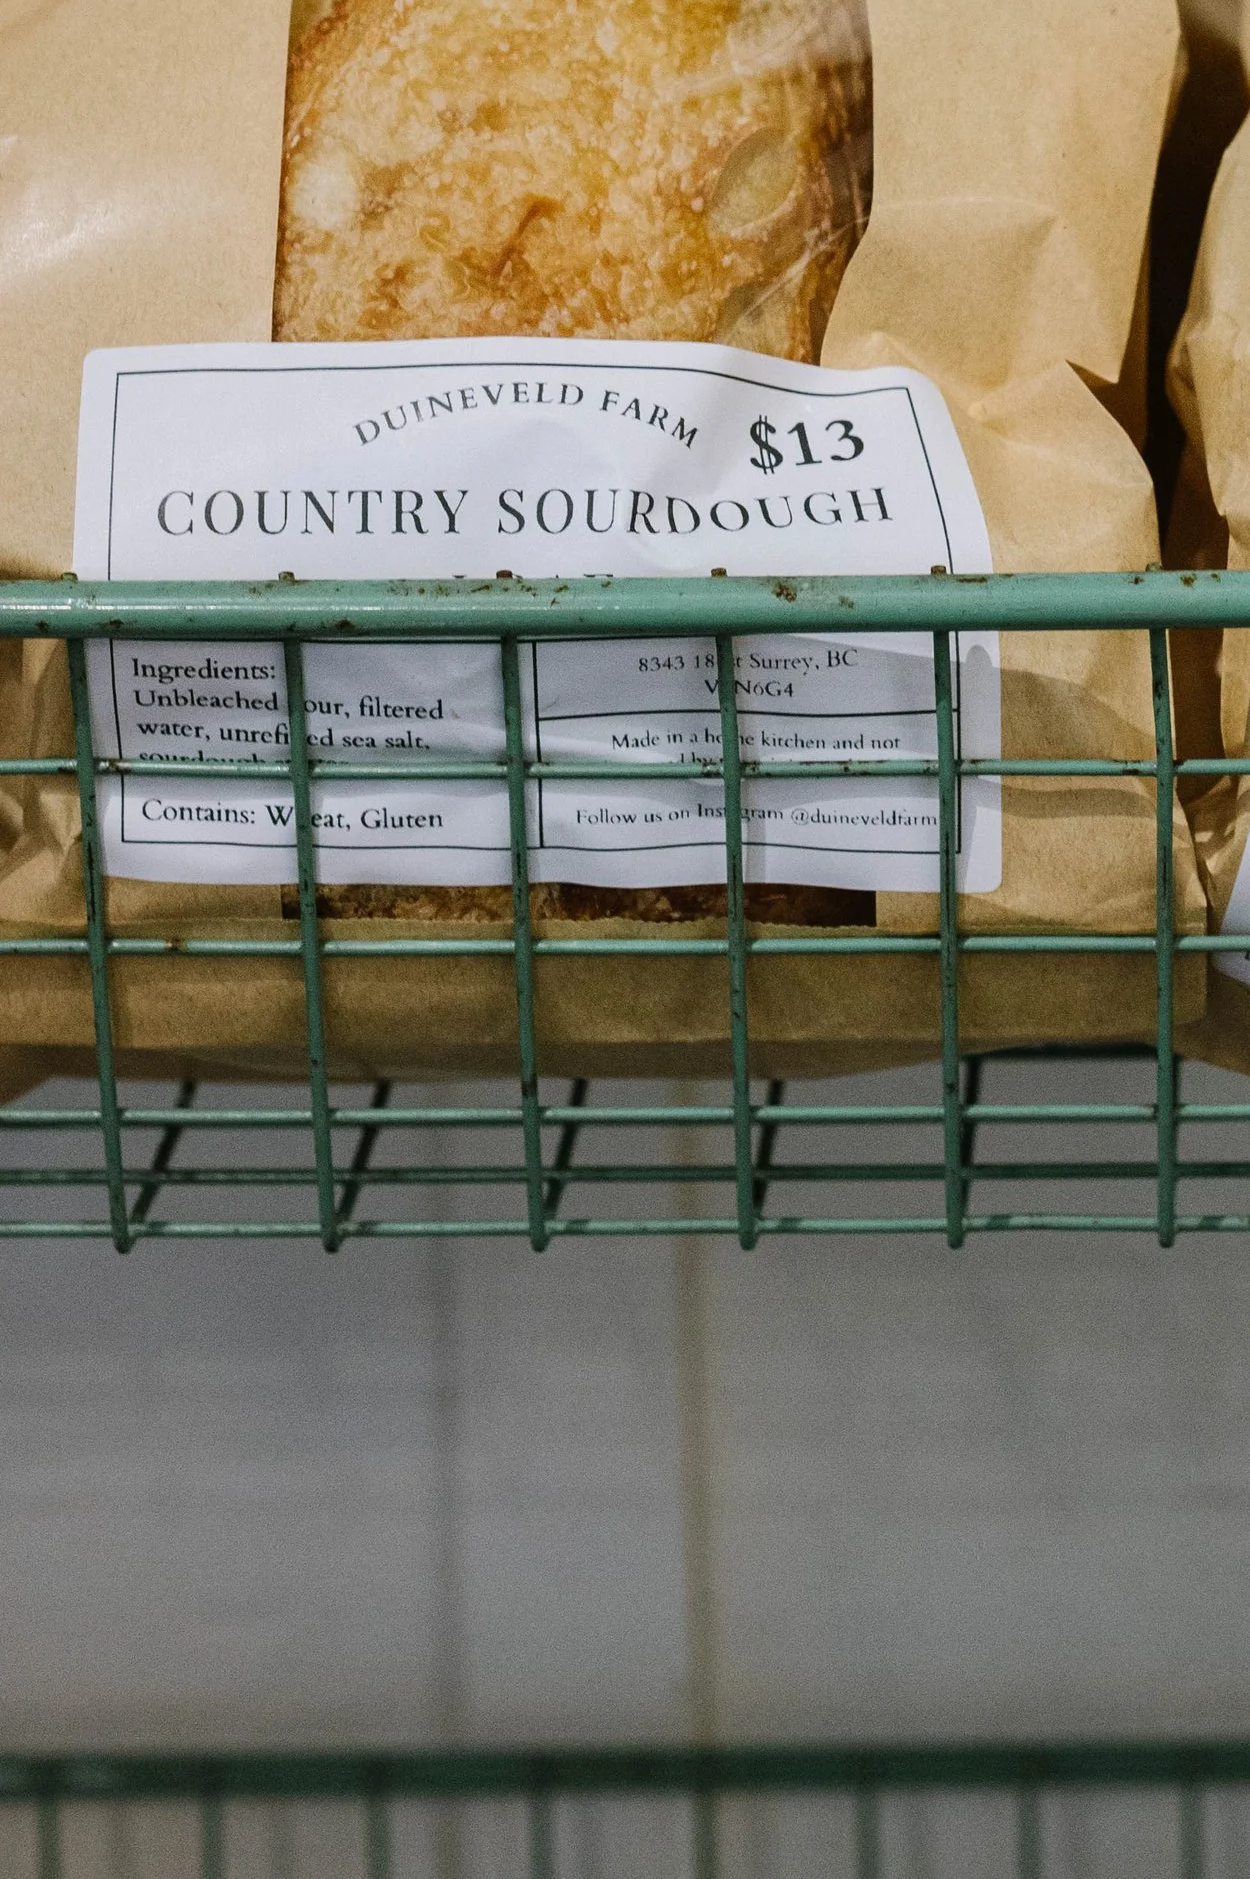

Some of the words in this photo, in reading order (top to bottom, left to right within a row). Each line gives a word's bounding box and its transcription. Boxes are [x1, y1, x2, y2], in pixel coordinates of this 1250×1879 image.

[352, 381, 586, 447] DUINEVELD
[600, 389, 698, 450] FARM
[748, 414, 866, 476] $13
[156, 487, 468, 536] COUNTRY
[496, 485, 895, 535] SOURDOUGH
[131, 657, 276, 685] Ingredients:
[638, 654, 686, 672] 8343
[749, 651, 820, 676] Surrey,
[826, 648, 859, 669] BC
[704, 679, 794, 698] VN6G4
[132, 688, 280, 712] Unbleached
[302, 697, 350, 719] our,
[359, 694, 444, 720] filtered
[136, 722, 211, 742] water,
[219, 721, 334, 748] unrefied
[342, 734, 377, 748] sea
[612, 729, 660, 750] Made
[667, 728, 683, 744] in
[689, 732, 699, 744] a
[761, 730, 826, 750] kitchen
[832, 733, 865, 750] and
[870, 737, 901, 750] not
[141, 797, 256, 825] Contains:
[264, 803, 351, 831] Weat,
[359, 807, 444, 829] Gluten
[576, 808, 637, 825] Follow
[643, 809, 663, 824] us
[667, 808, 691, 821] on
[697, 803, 784, 823] Insgram
[790, 806, 938, 827] @duineveldfarm
